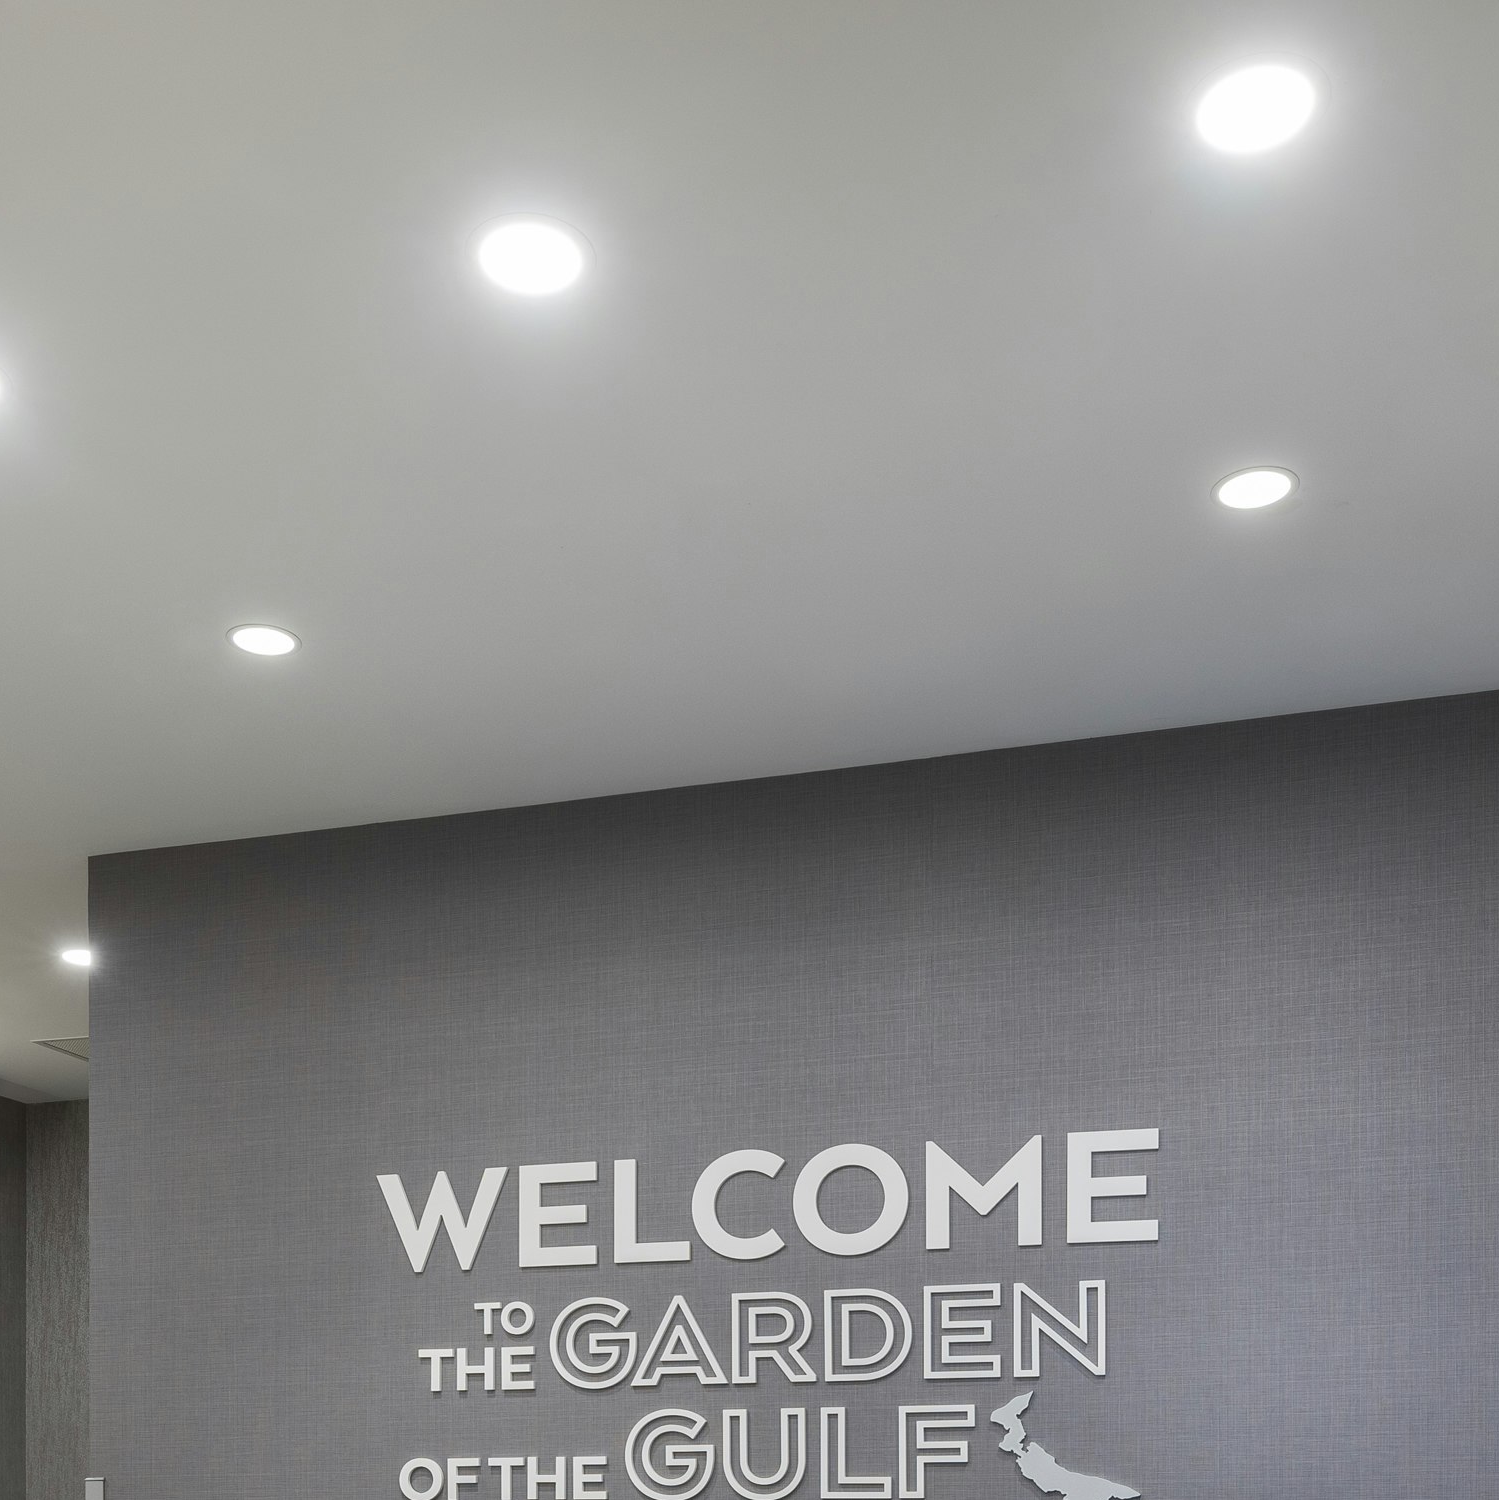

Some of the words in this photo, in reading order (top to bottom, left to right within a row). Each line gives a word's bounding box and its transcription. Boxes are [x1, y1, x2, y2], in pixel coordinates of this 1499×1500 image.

[376, 1127, 1161, 1274] WELCOME
[418, 1346, 536, 1393] THE
[548, 1279, 1106, 1391] GARDEN
[473, 1300, 535, 1337] TO
